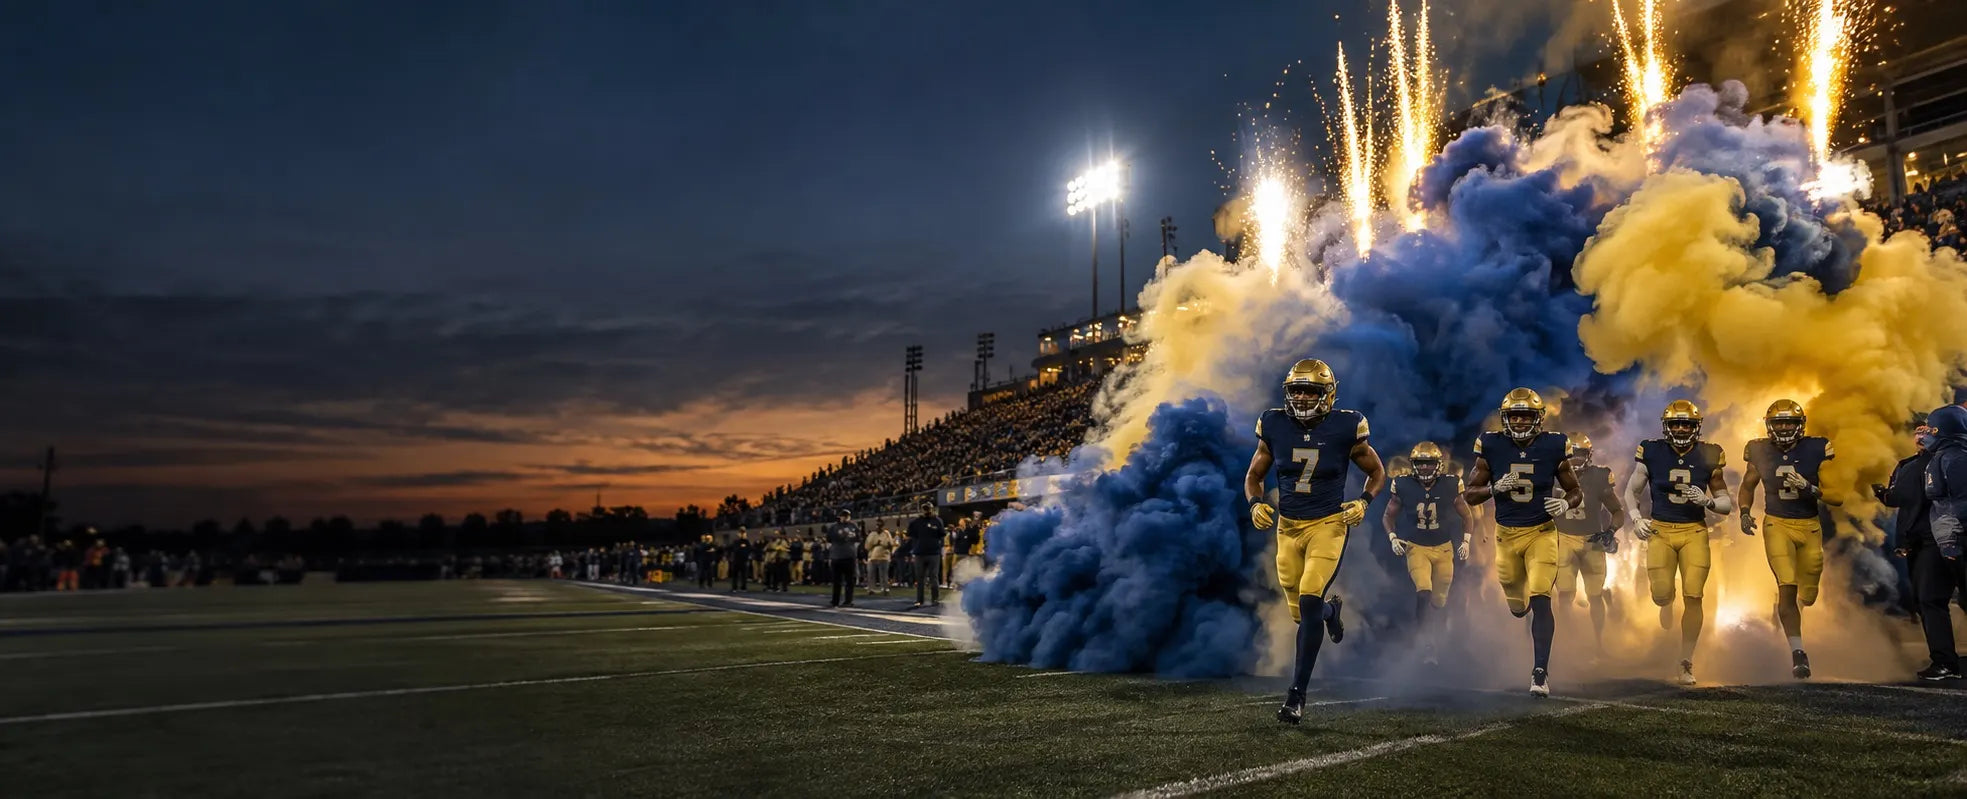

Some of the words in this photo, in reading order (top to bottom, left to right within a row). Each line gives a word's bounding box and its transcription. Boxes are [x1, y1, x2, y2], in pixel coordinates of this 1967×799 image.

[1293, 448, 1319, 493] 7
[1510, 463, 1535, 502] 5
[1668, 468, 1691, 504] 3
[1776, 465, 1798, 500] 3
[1416, 502, 1439, 530] 11
